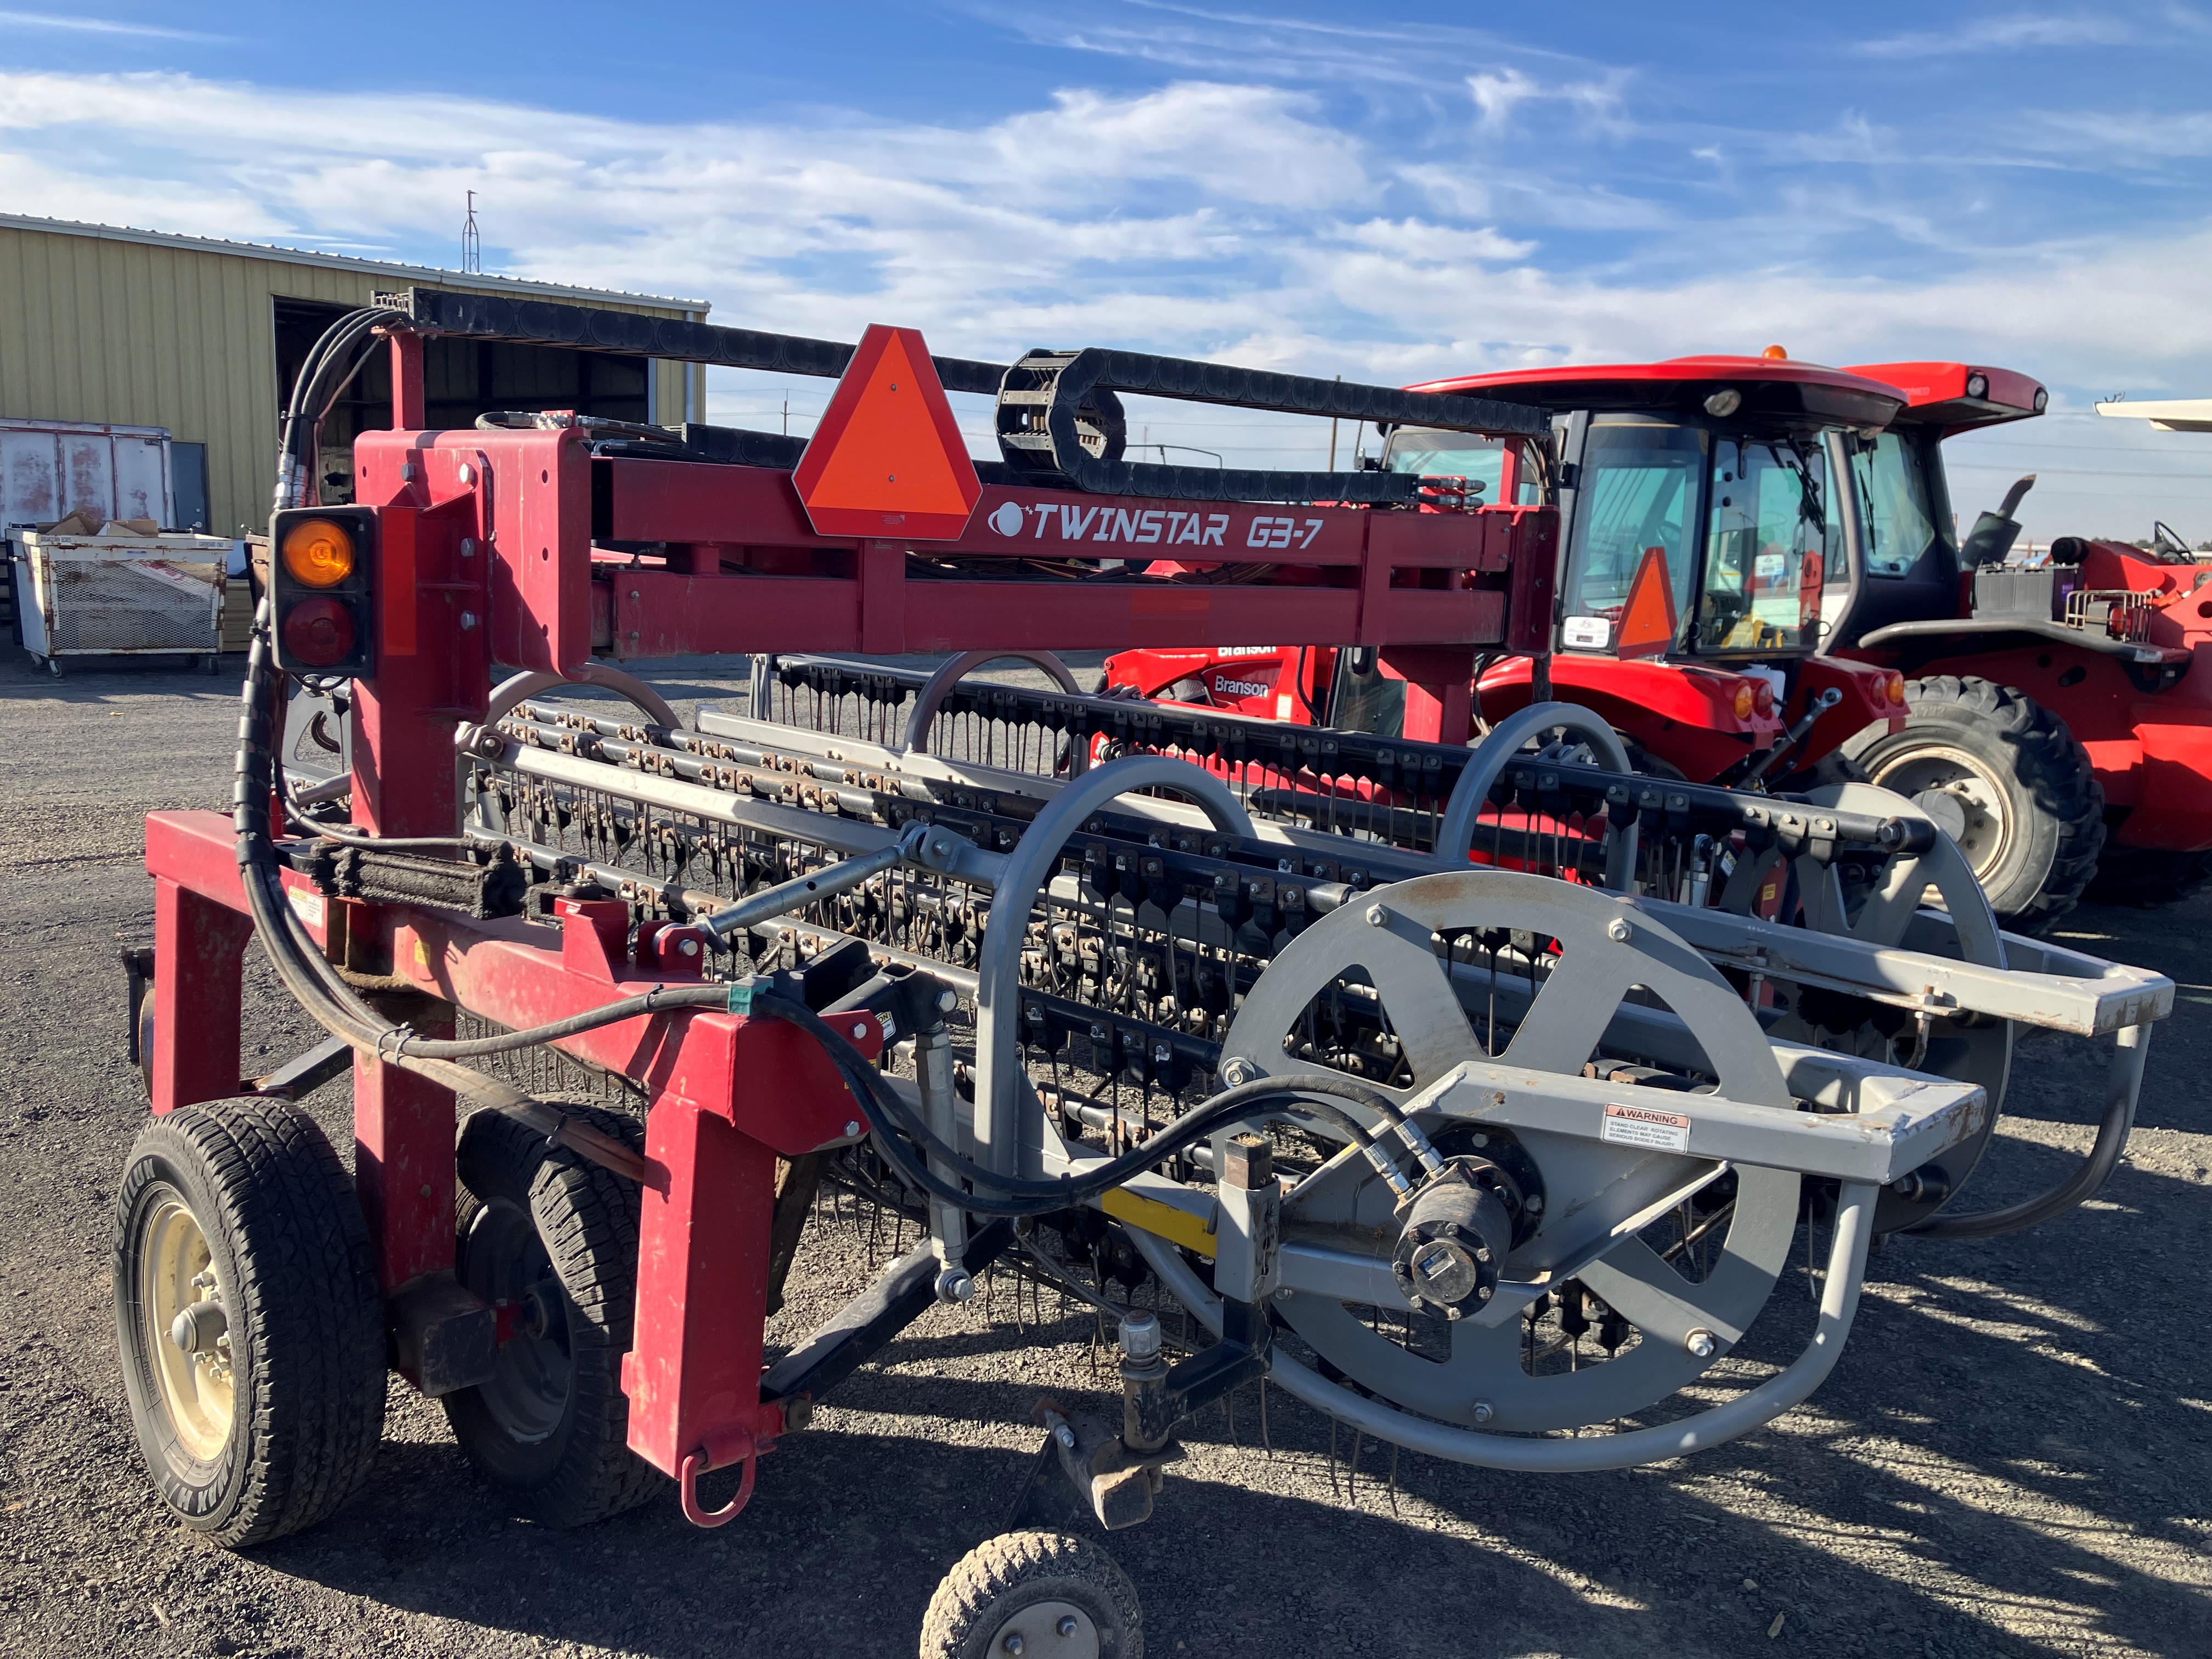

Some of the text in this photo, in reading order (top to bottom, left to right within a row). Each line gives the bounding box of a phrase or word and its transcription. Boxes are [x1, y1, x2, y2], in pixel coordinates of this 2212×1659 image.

[1034, 503, 1324, 550] TWINSTAR G3-7
[1215, 675, 1269, 698] Branson
[1627, 1109, 1678, 1125] WARNING
[1610, 1127, 1639, 1136] ELEMENTS
[1651, 1127, 1678, 1136] ROTATING
[115, 1158, 156, 1250] SAILUN
